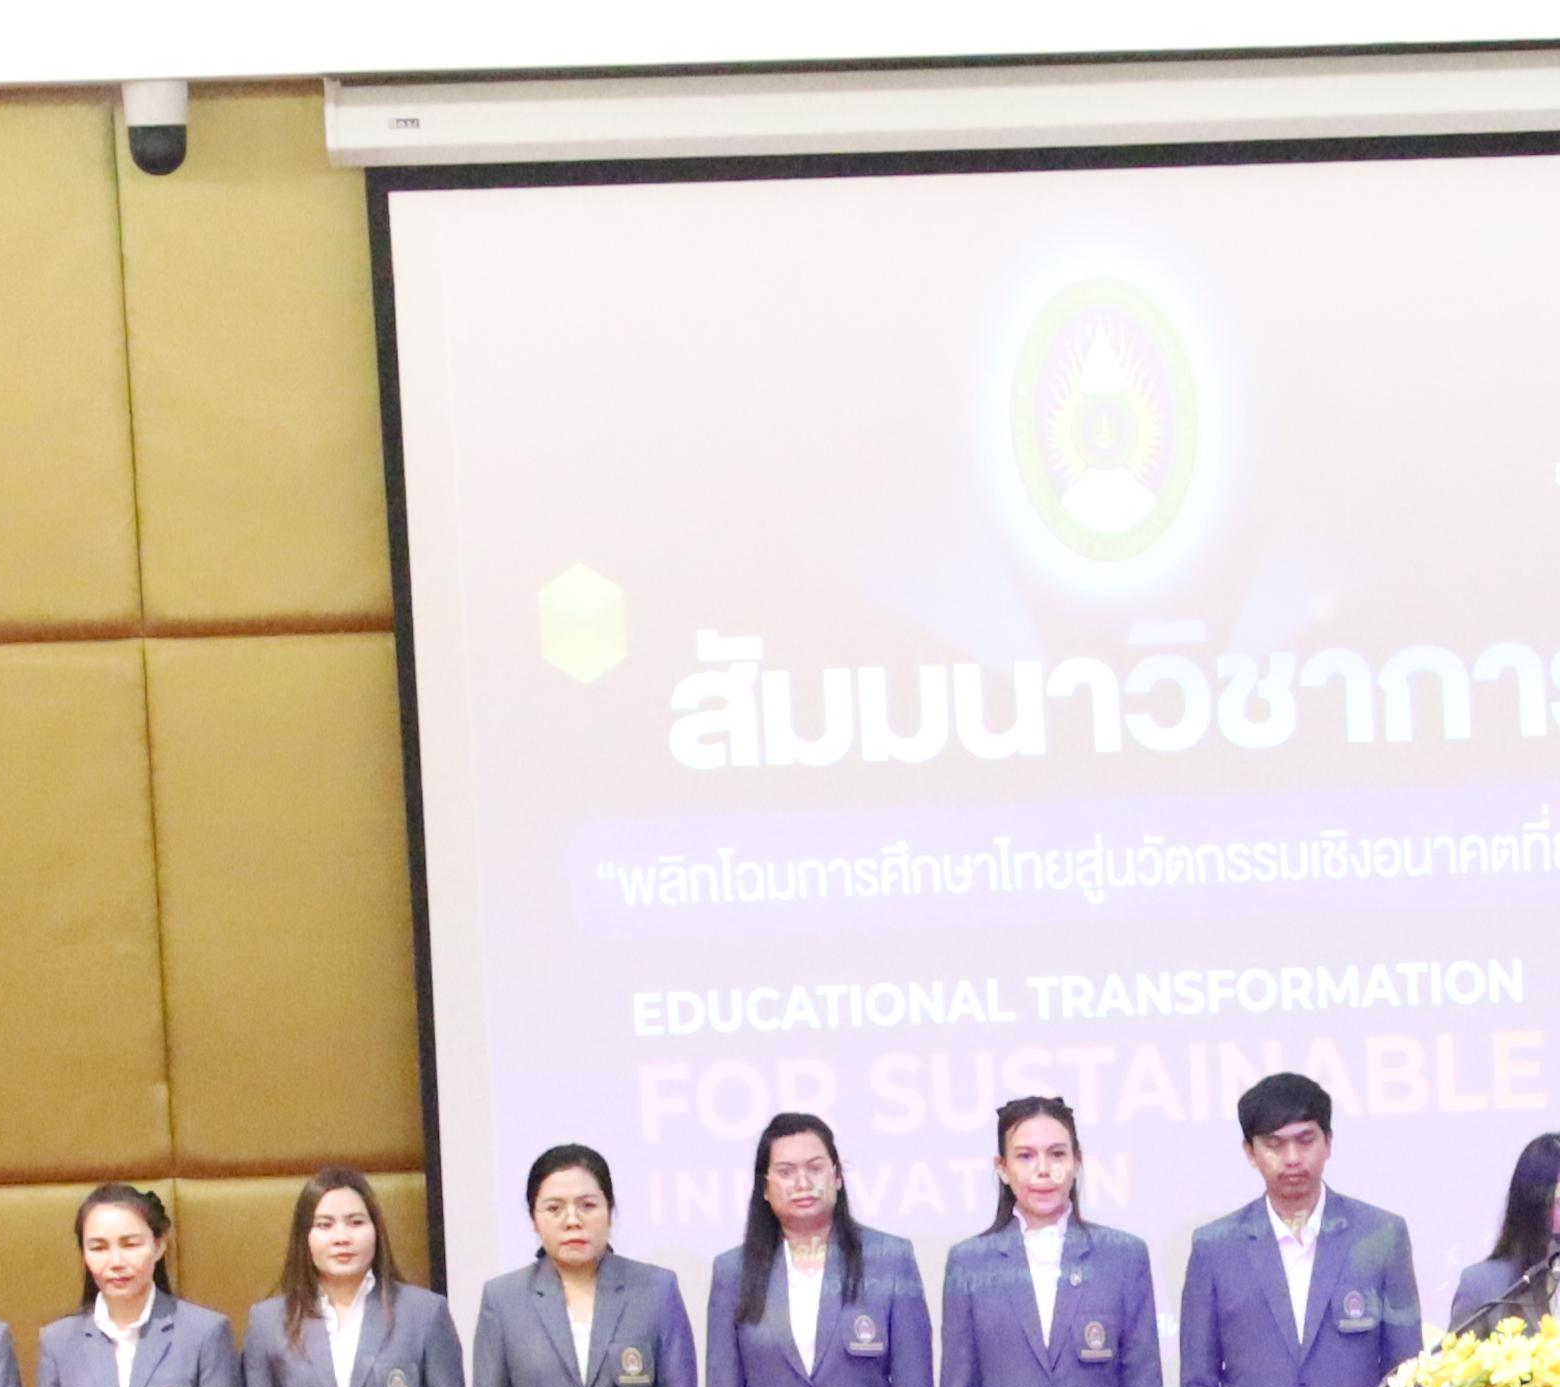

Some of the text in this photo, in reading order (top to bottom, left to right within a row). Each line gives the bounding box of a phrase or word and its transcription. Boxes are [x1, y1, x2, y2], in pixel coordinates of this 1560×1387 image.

[633, 958, 1525, 1036] EDUCATIONAL TRANSFORMATION
[636, 1054, 841, 1144] FOR
